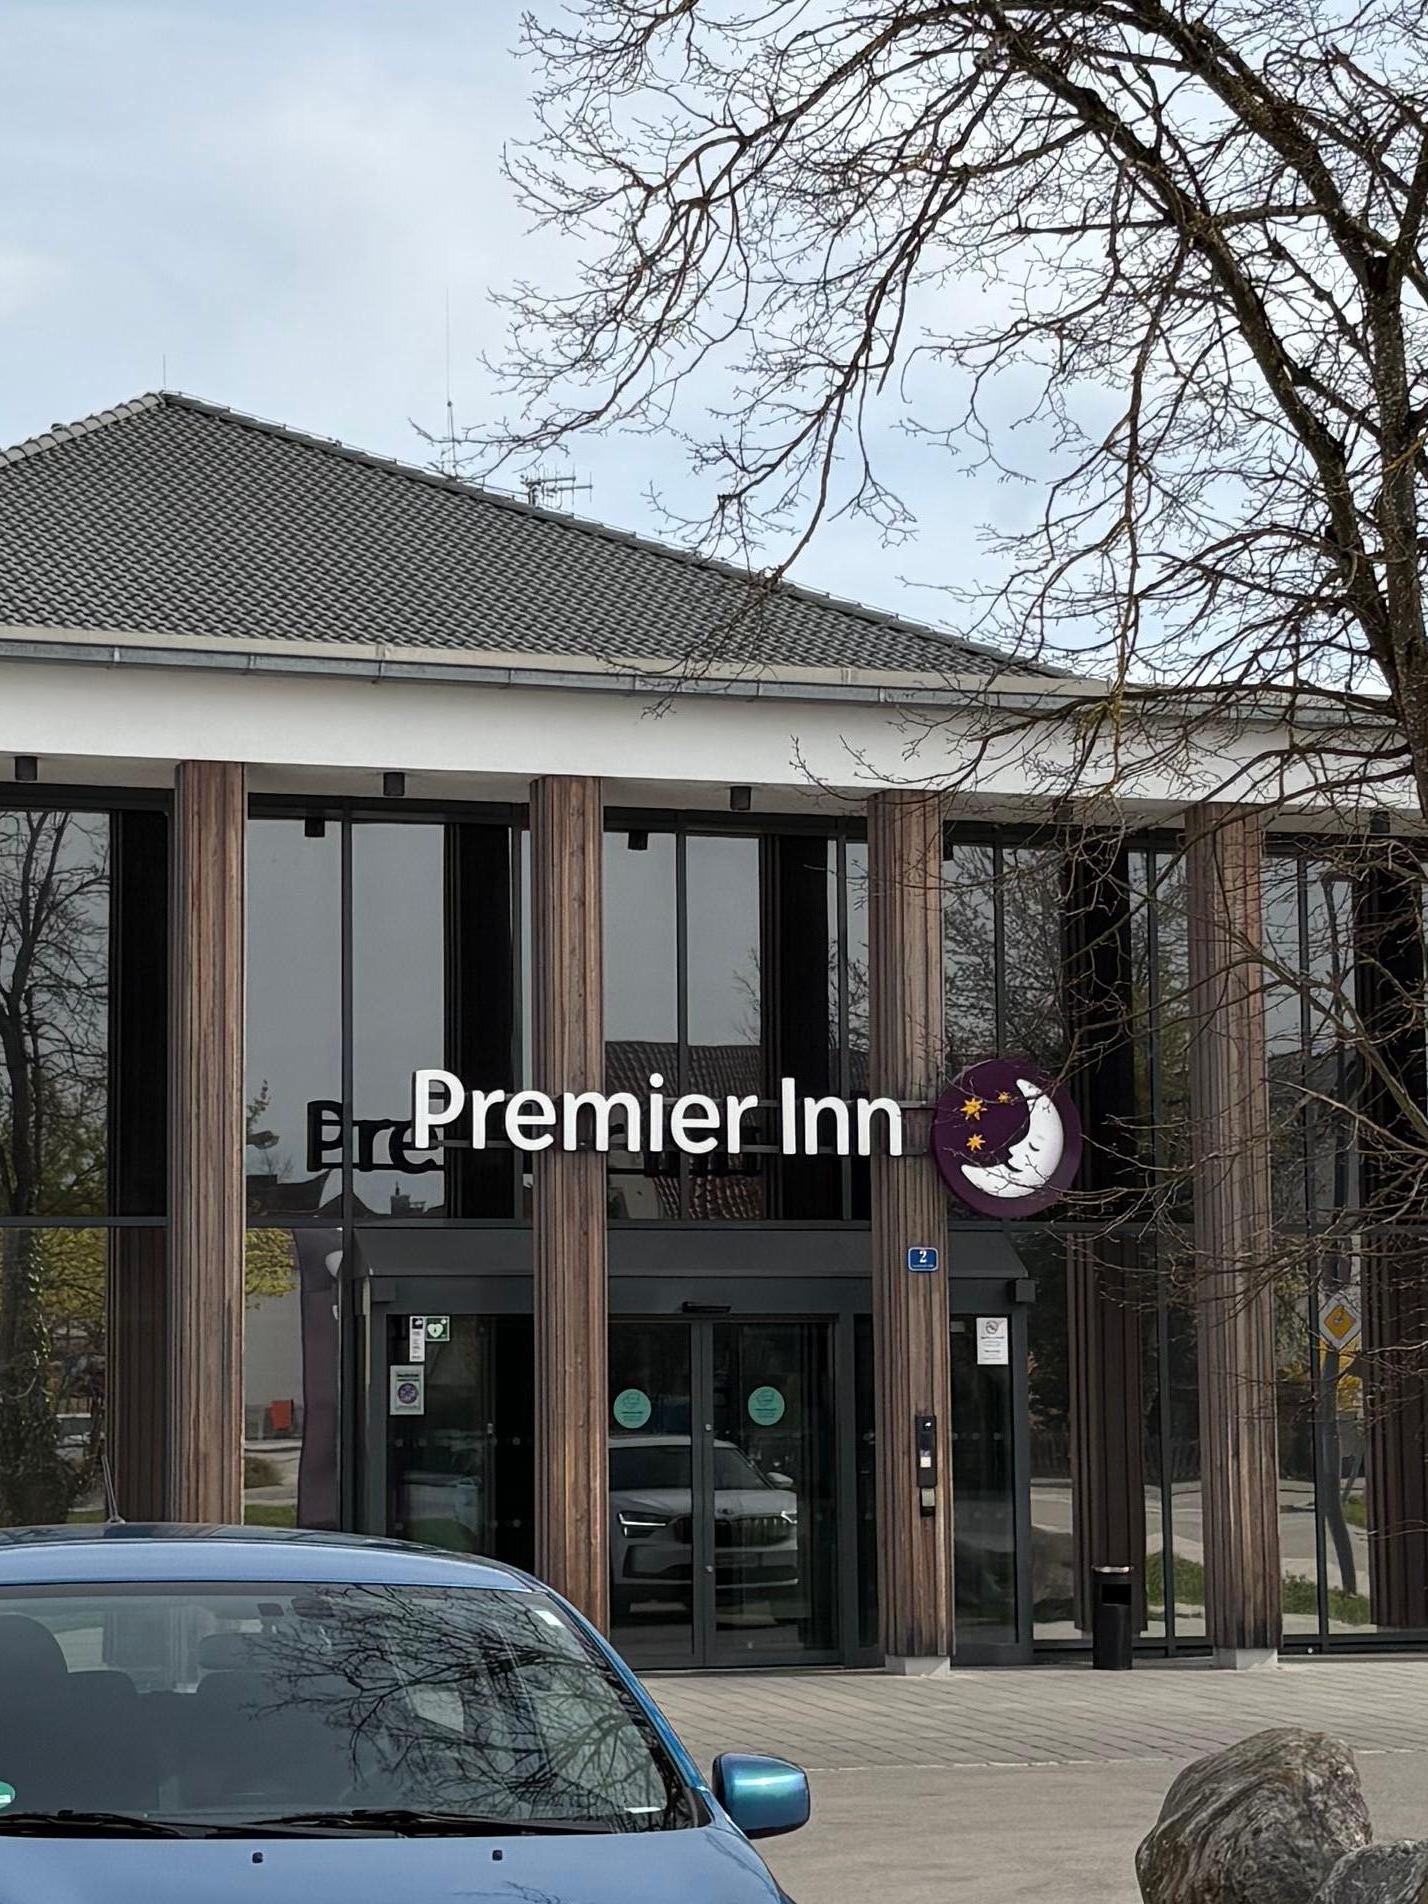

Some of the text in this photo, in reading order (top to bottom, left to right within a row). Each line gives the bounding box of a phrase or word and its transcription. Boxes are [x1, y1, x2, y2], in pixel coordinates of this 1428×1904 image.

[414, 1069, 758, 1154] Premier
[781, 1077, 903, 1156] Inn
[919, 1250, 928, 1263] 2
